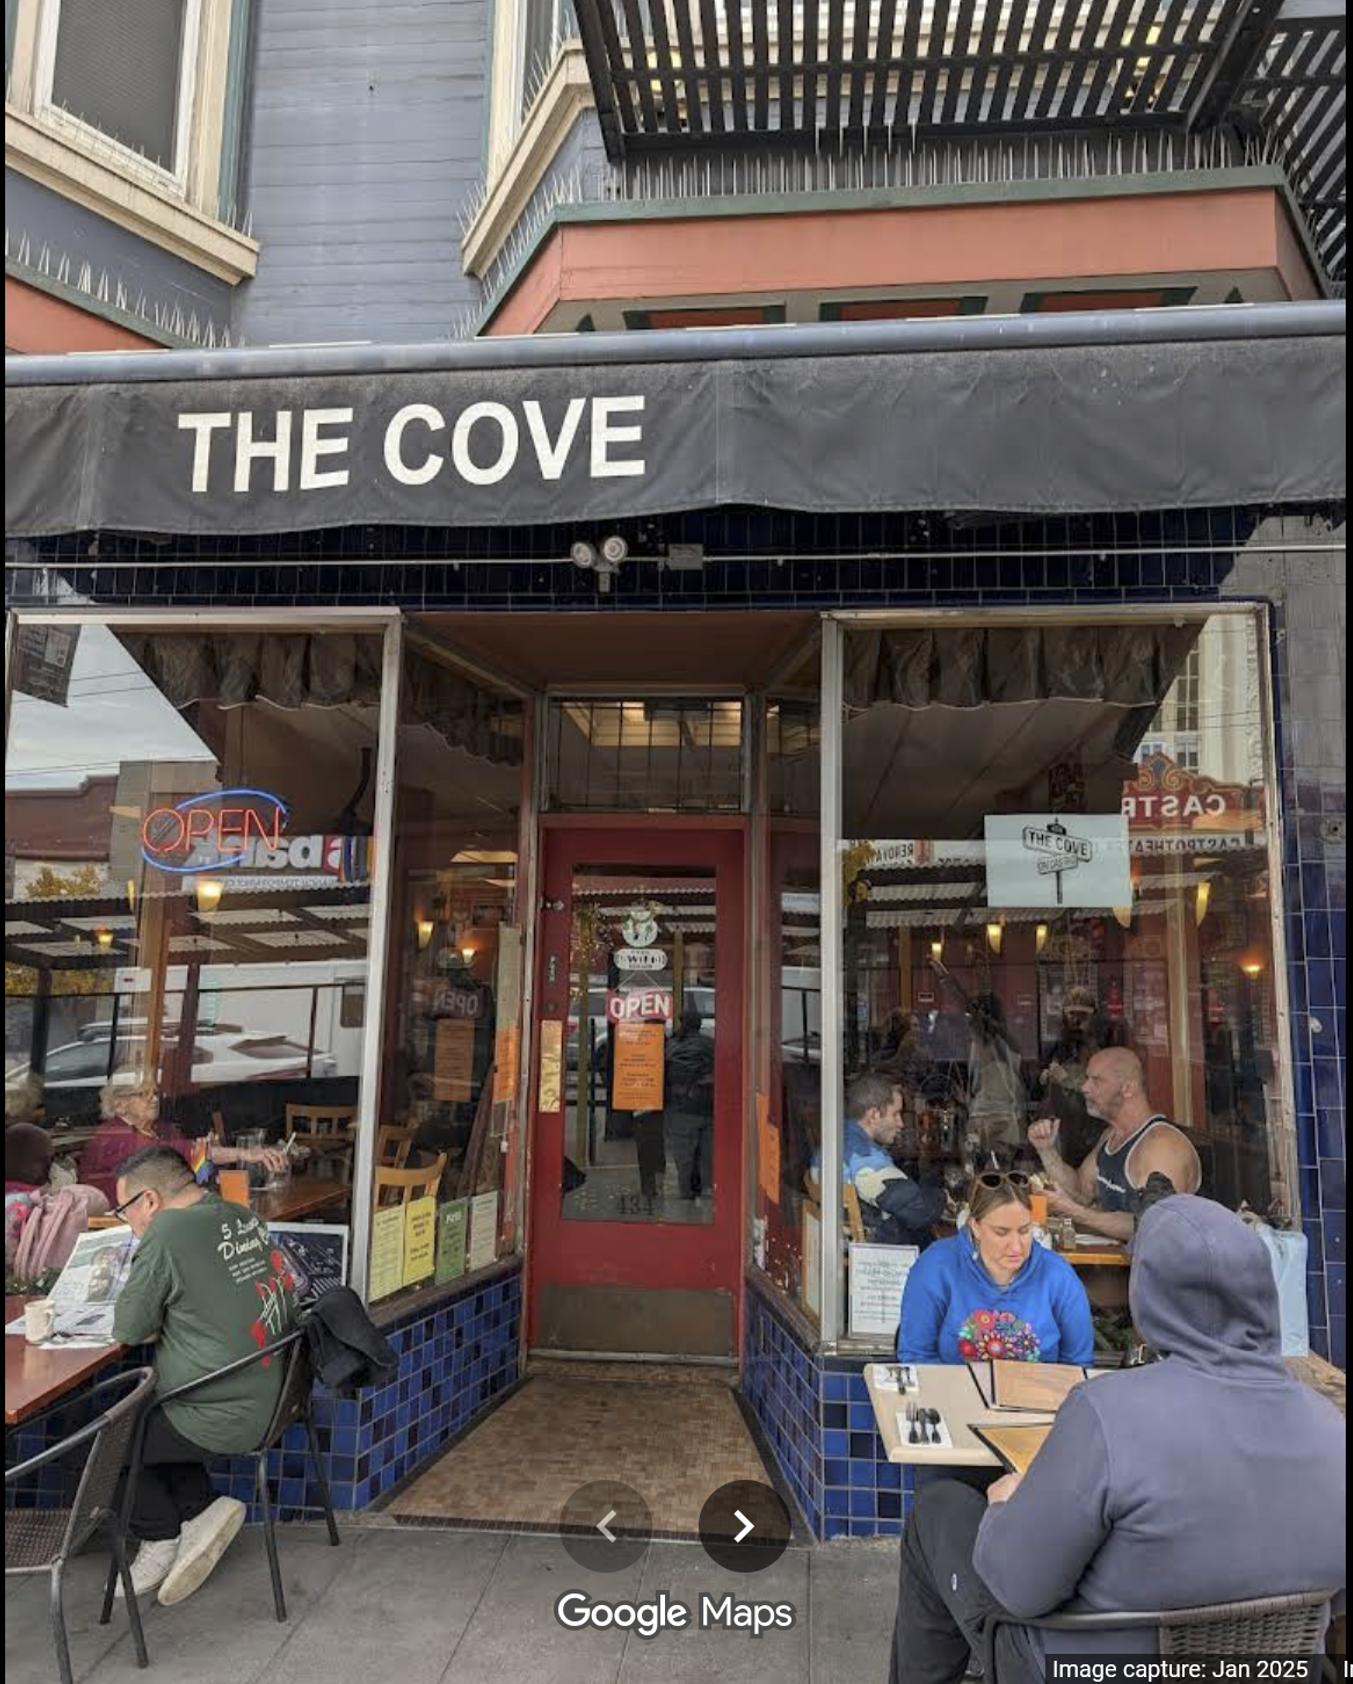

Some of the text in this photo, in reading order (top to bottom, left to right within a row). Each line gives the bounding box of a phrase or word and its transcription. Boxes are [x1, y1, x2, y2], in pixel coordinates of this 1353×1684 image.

[178, 395, 646, 493] THE COVE
[142, 806, 280, 852] OPEN
[1028, 830, 1088, 856] THE COVE
[610, 994, 671, 1019] OPEN
